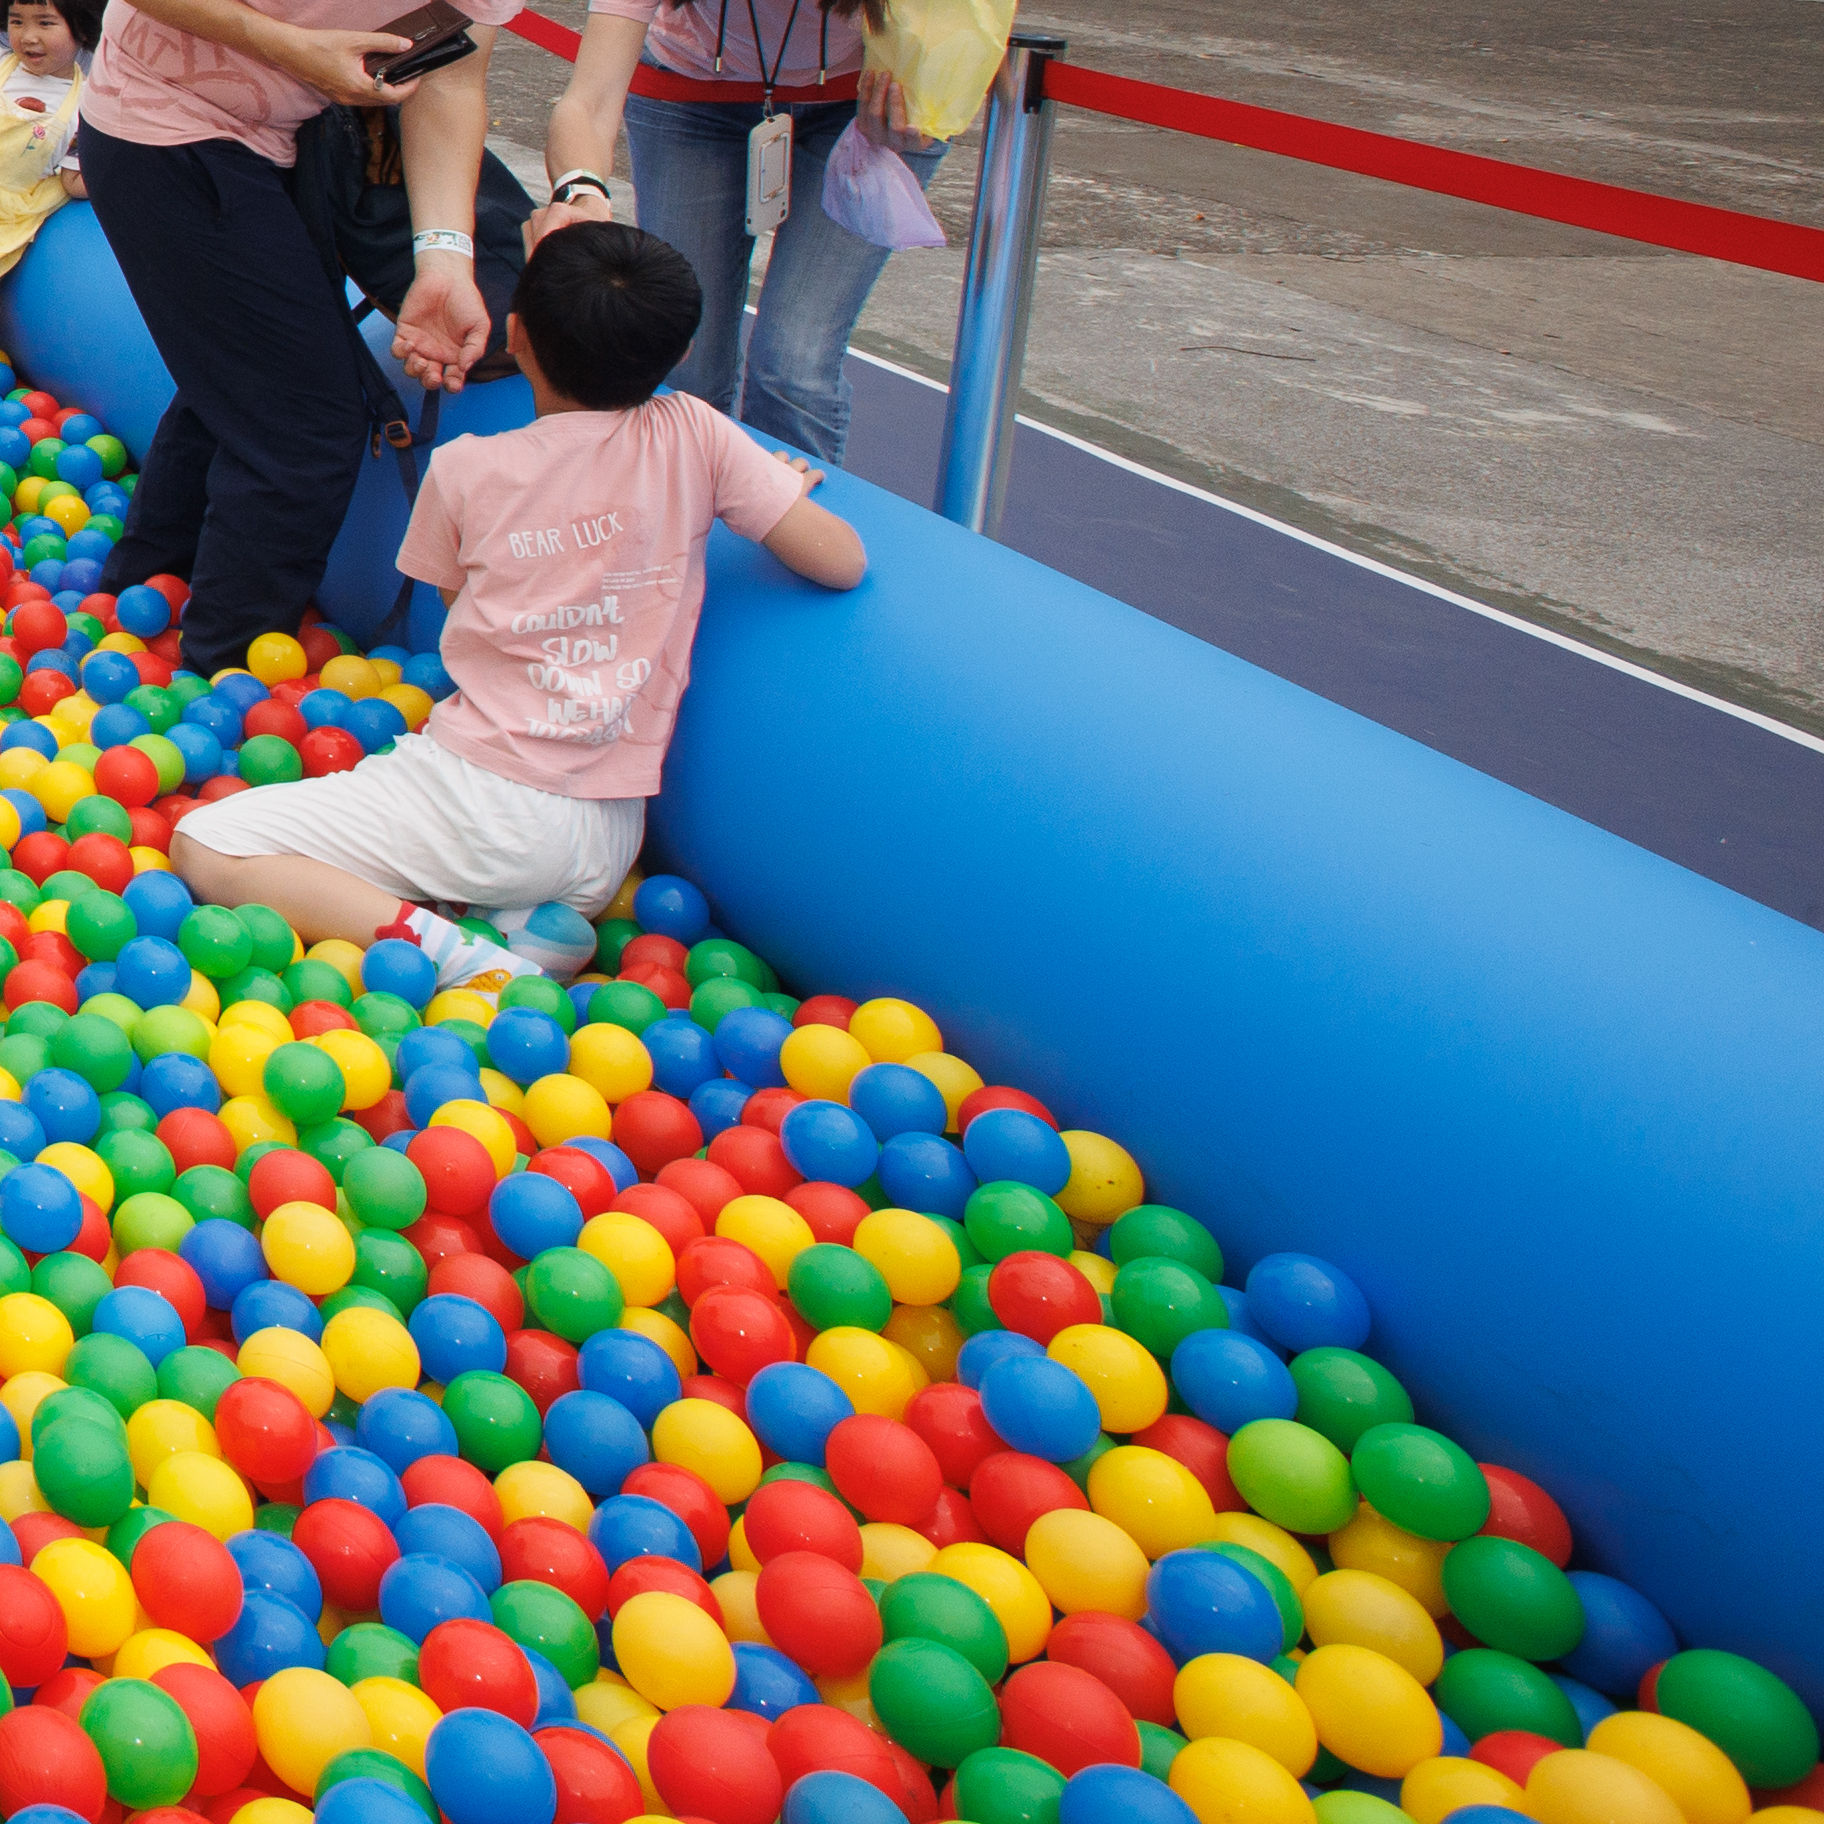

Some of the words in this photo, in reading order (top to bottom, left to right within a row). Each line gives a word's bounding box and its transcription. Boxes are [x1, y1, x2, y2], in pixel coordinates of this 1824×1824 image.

[508, 528, 565, 559] BEAR
[571, 511, 624, 549] LUCK
[541, 634, 618, 667] SLOW
[527, 662, 603, 696] DOWN
[616, 657, 652, 689] SO
